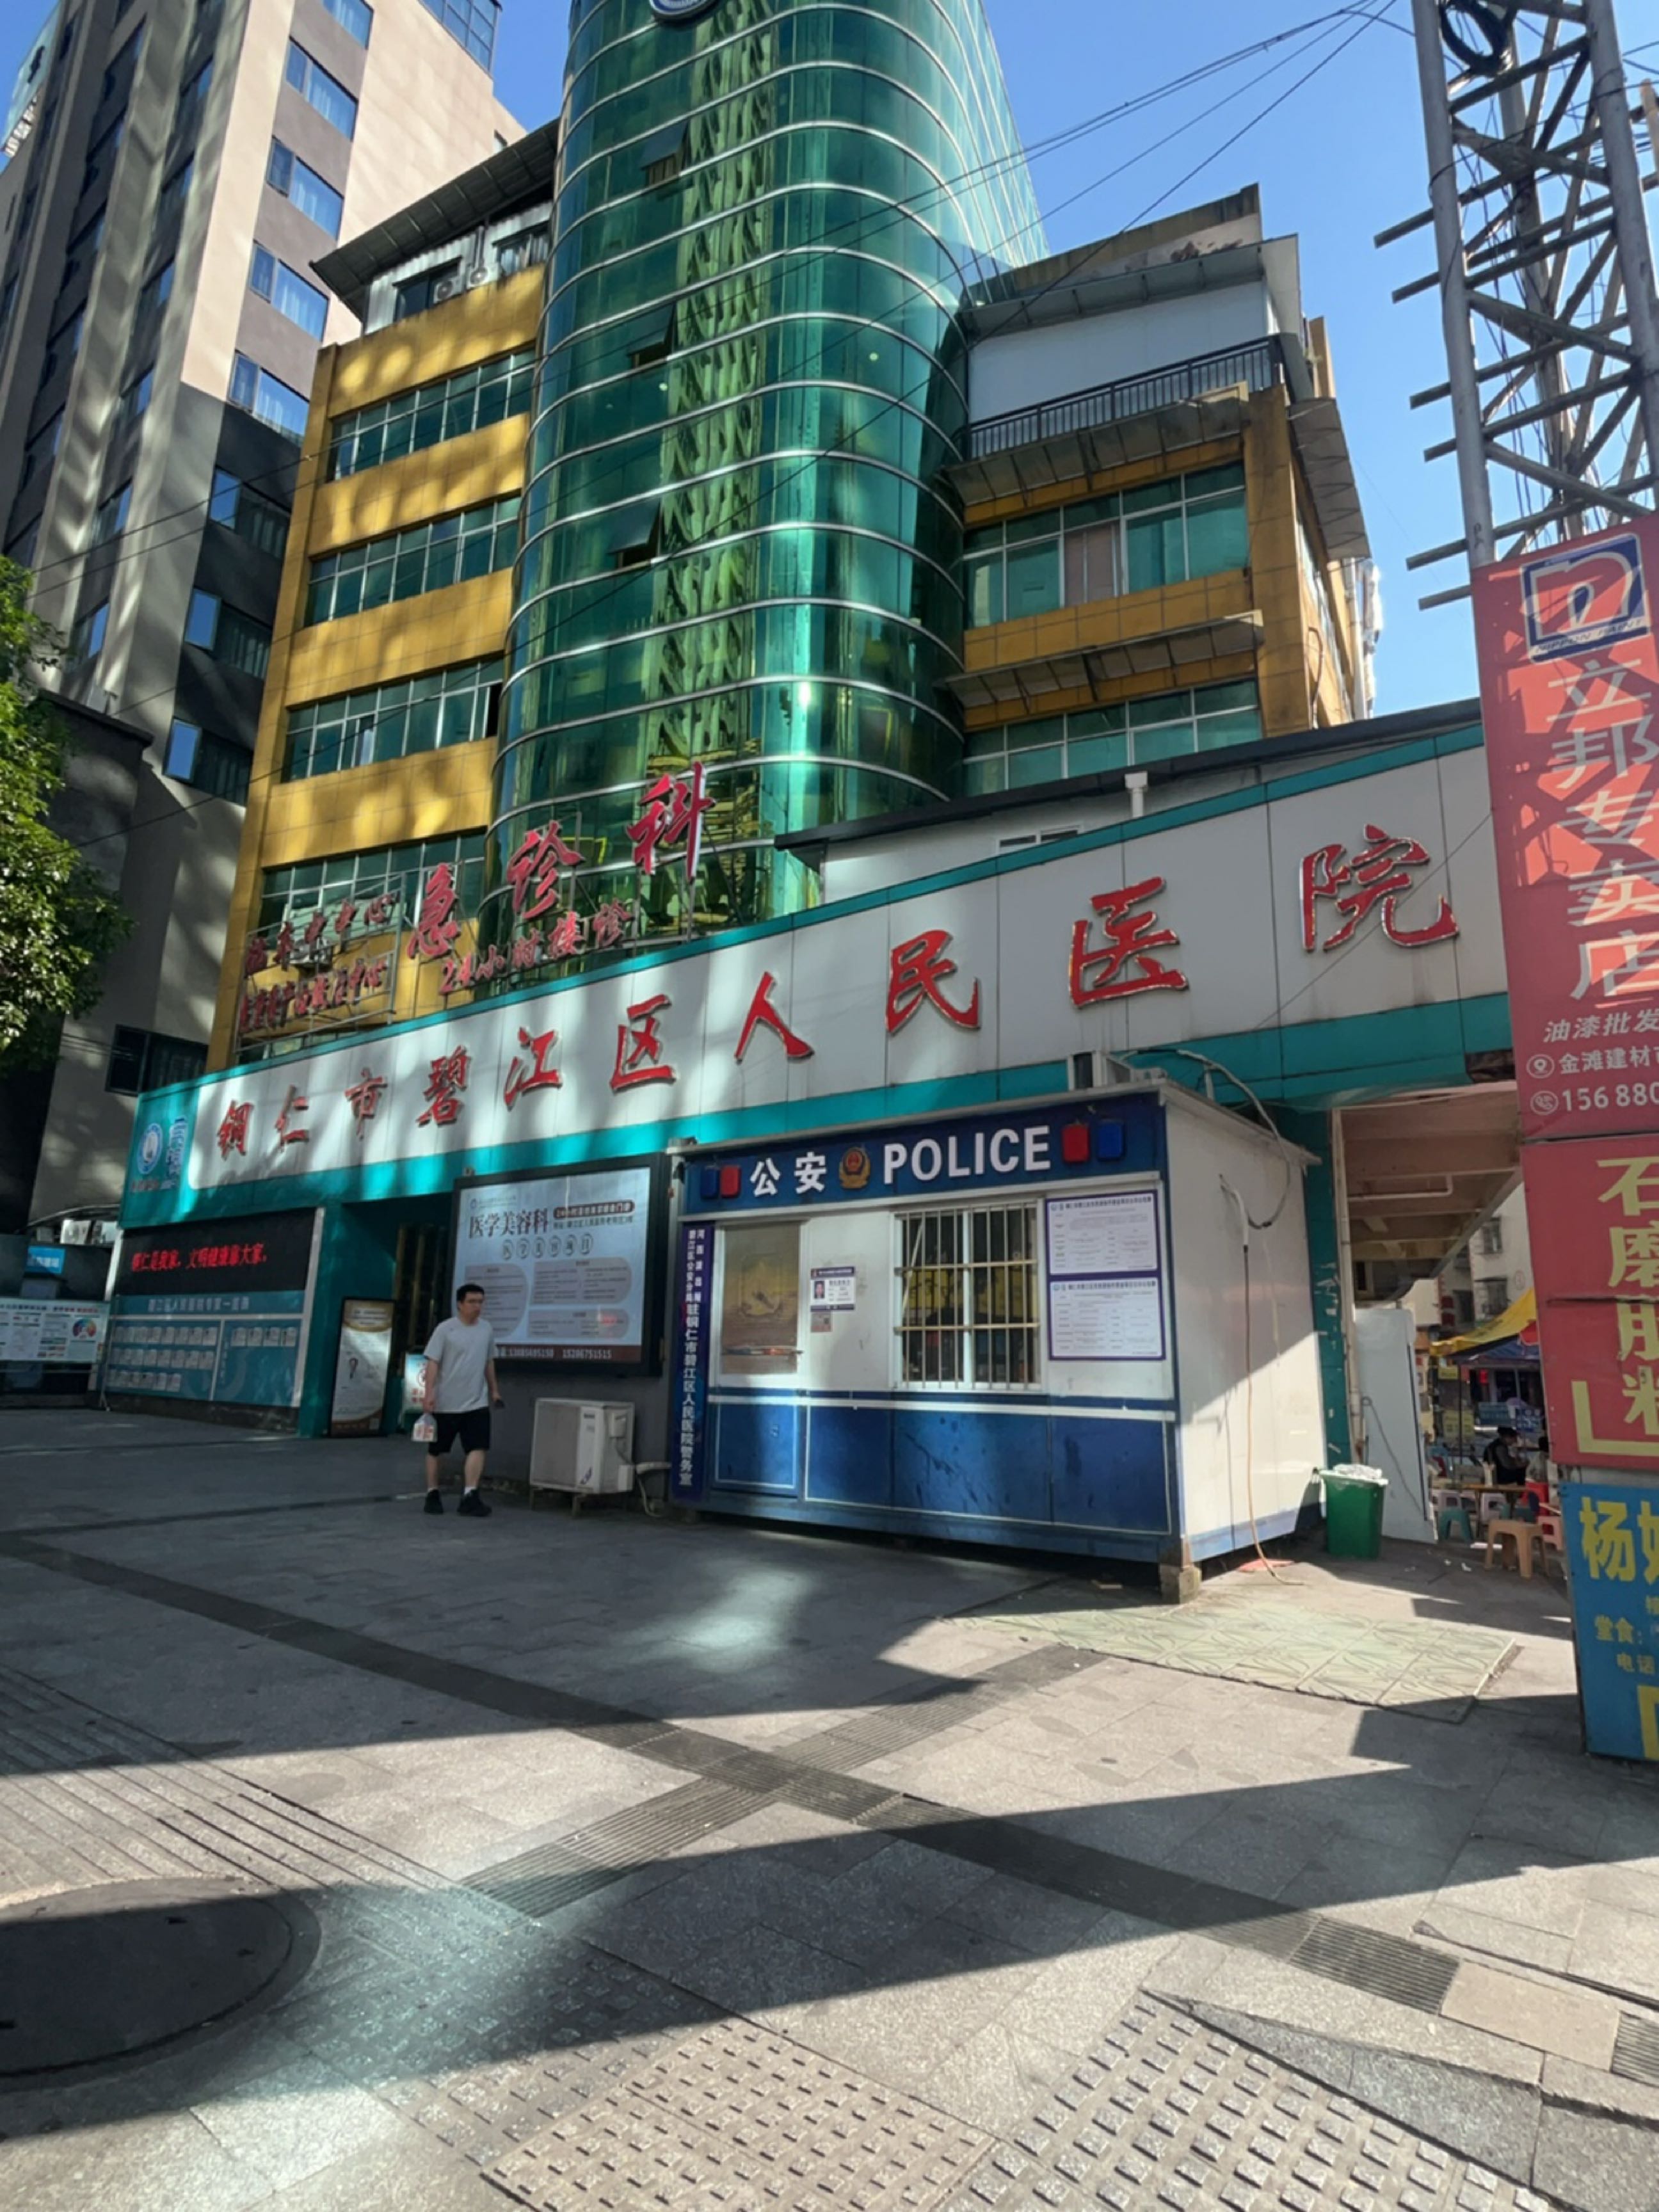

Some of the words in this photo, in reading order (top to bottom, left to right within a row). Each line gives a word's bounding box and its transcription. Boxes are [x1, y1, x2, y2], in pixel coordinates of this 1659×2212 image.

[1546, 659, 1659, 1000] 立邦专卖店
[408, 762, 716, 959] 急诊科
[216, 826, 1461, 1160] 铜仁市碧江区人民医院
[1543, 1008, 1659, 1043] 油漆批发
[1559, 1045, 1659, 1075] 金滩建材
[1562, 1086, 1609, 1111] 156
[749, 1151, 828, 1197] 公安
[883, 1125, 1052, 1184] POLICE
[469, 1208, 549, 1238] 医学美容科
